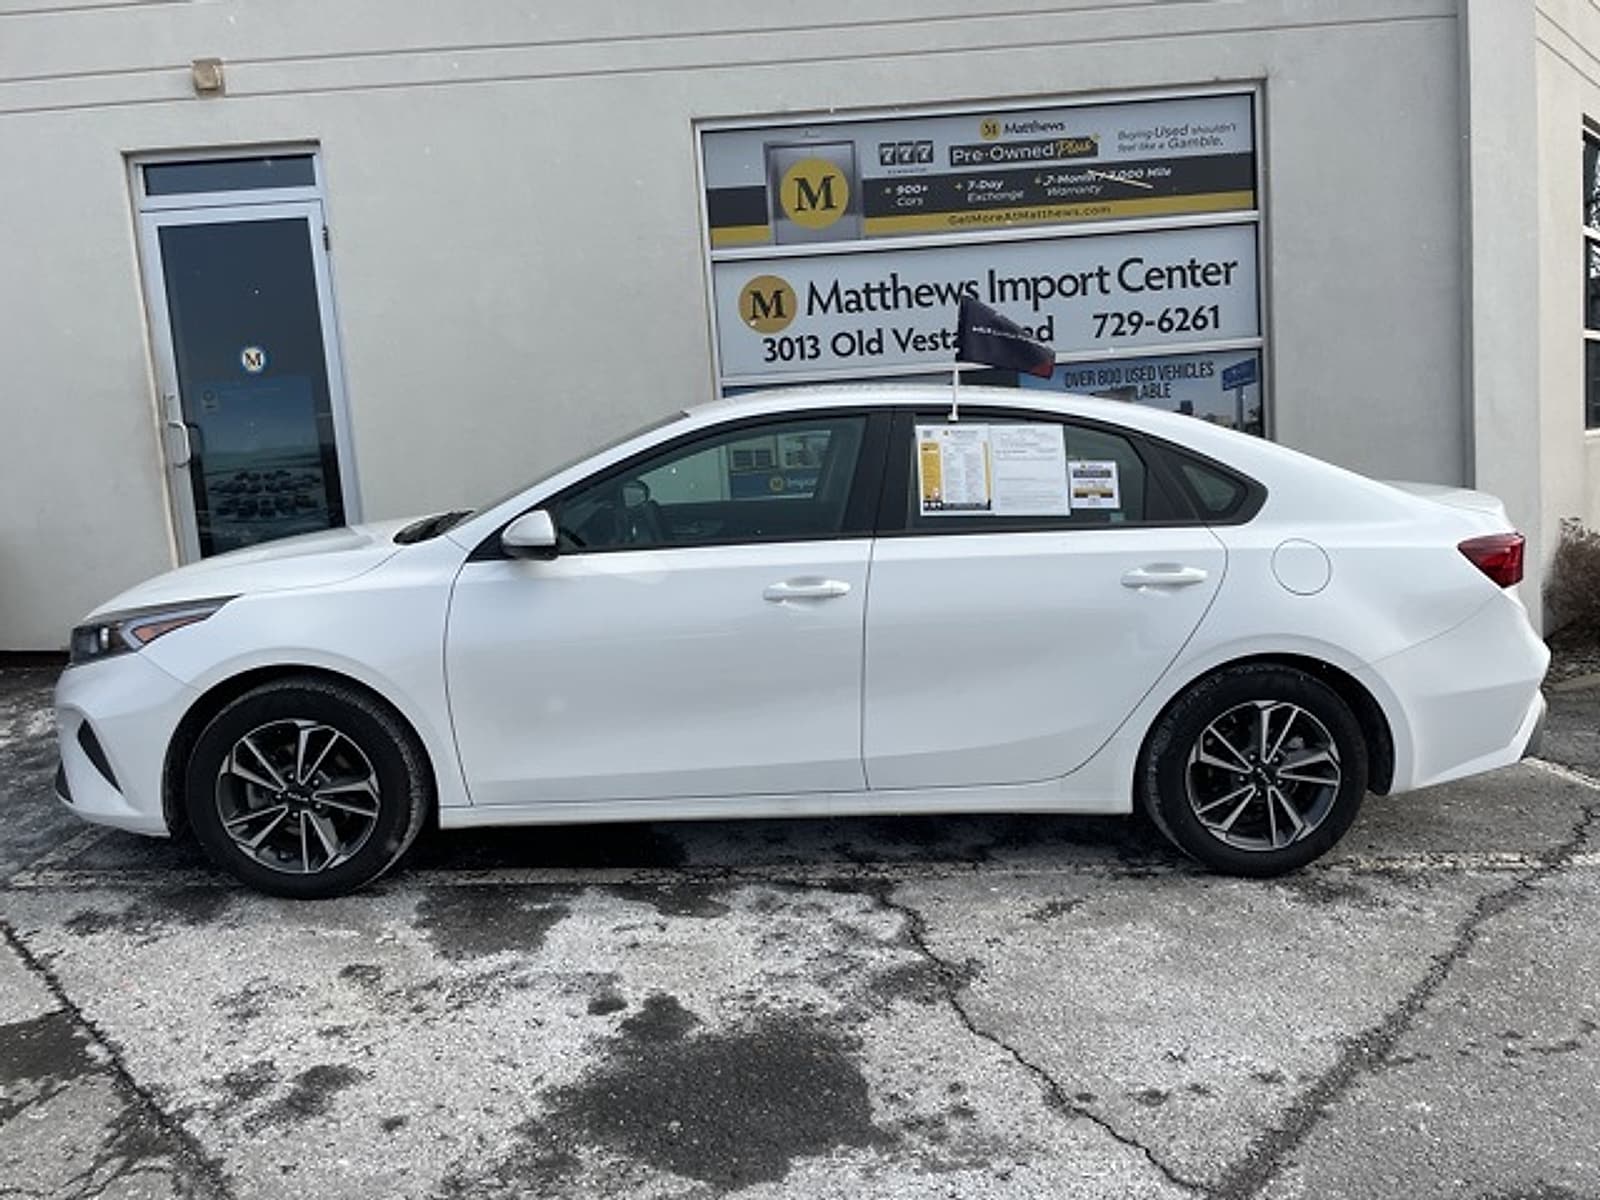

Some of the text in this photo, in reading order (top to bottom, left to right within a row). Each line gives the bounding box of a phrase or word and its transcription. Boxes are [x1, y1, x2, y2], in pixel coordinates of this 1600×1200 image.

[1003, 118, 1066, 136] Matthews
[1155, 123, 1189, 139] Used
[793, 174, 838, 212] M
[967, 190, 1024, 204] Exchange
[749, 257, 1239, 319] M Matthews Import Center
[1093, 304, 1221, 339] 729-6261
[245, 353, 261, 366] M
[763, 334, 821, 362] 3013
[831, 328, 884, 356] Old
[1064, 370, 1096, 389] OVER
[1098, 366, 1121, 387] 800
[1125, 364, 1156, 384] USED
[1158, 360, 1214, 382] VEHICLES
